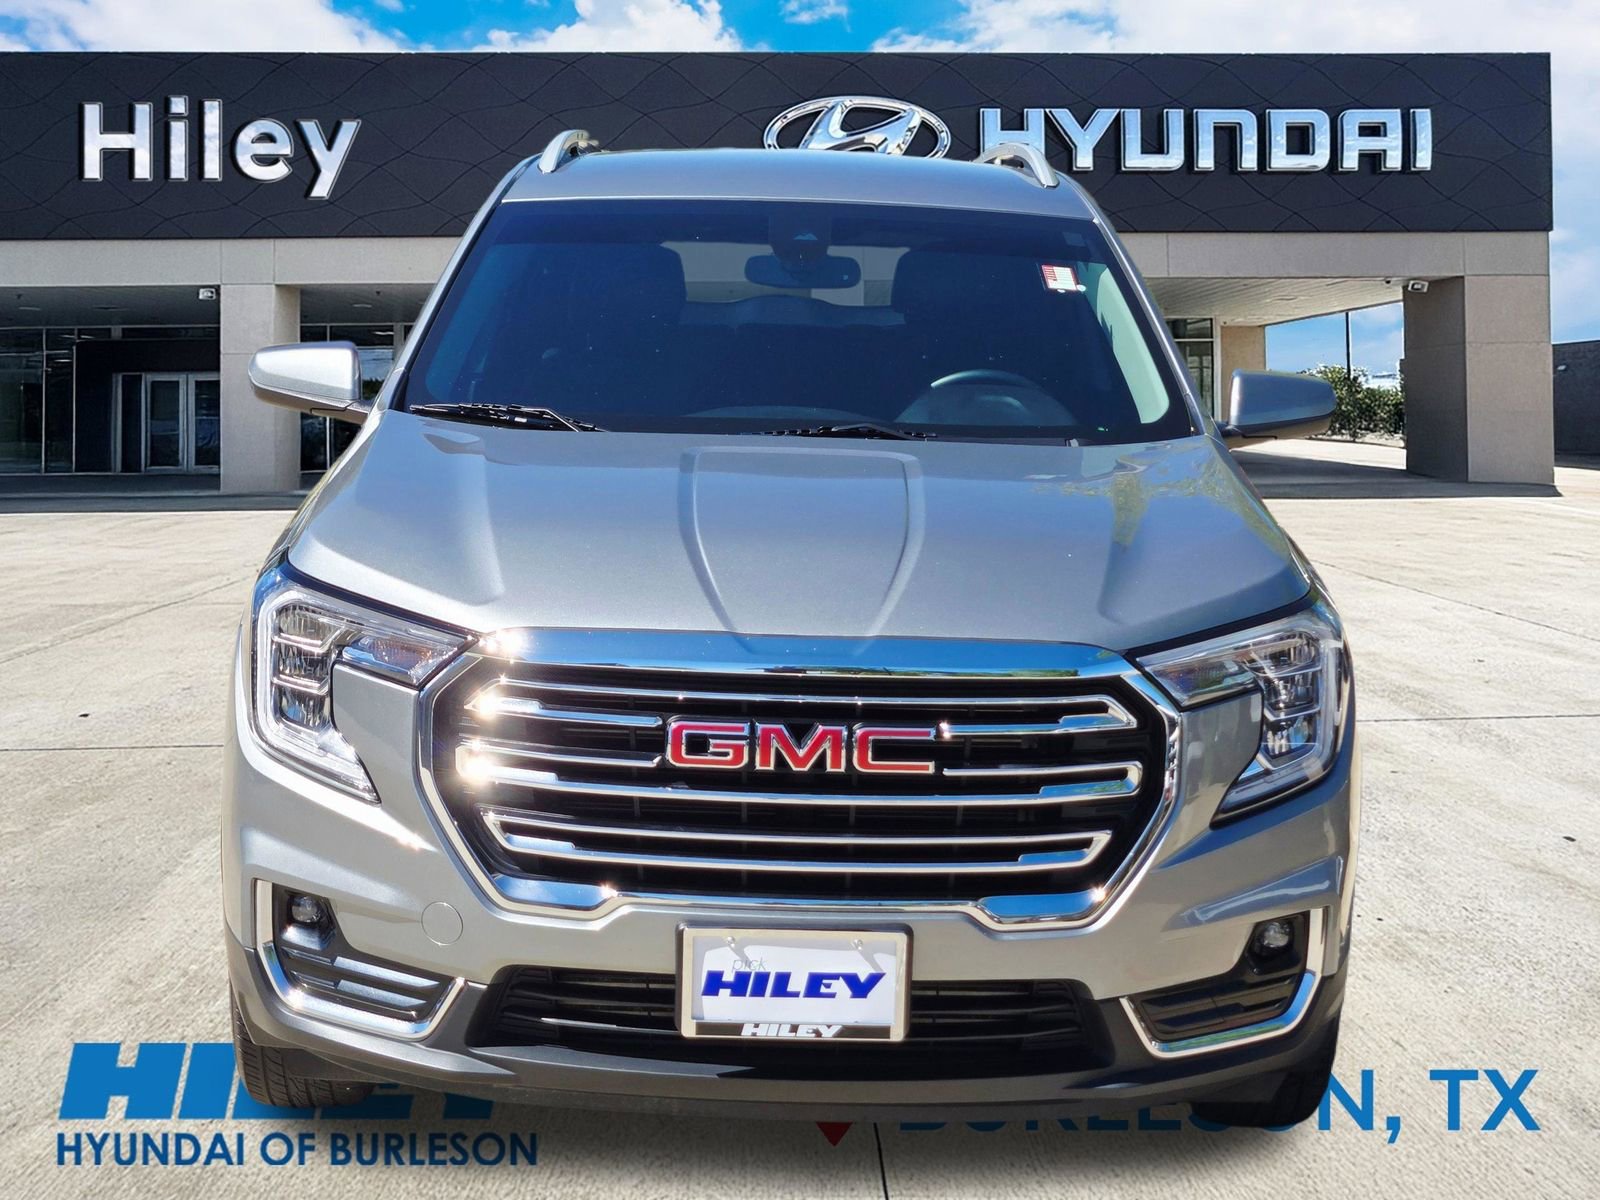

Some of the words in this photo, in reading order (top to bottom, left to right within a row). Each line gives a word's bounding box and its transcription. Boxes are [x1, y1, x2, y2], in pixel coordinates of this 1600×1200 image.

[81, 95, 362, 199] Hiley
[979, 108, 1433, 172] HYUNDAI
[665, 717, 938, 774] GMC
[701, 970, 887, 998] HILEY
[740, 1023, 842, 1037] HILEY
